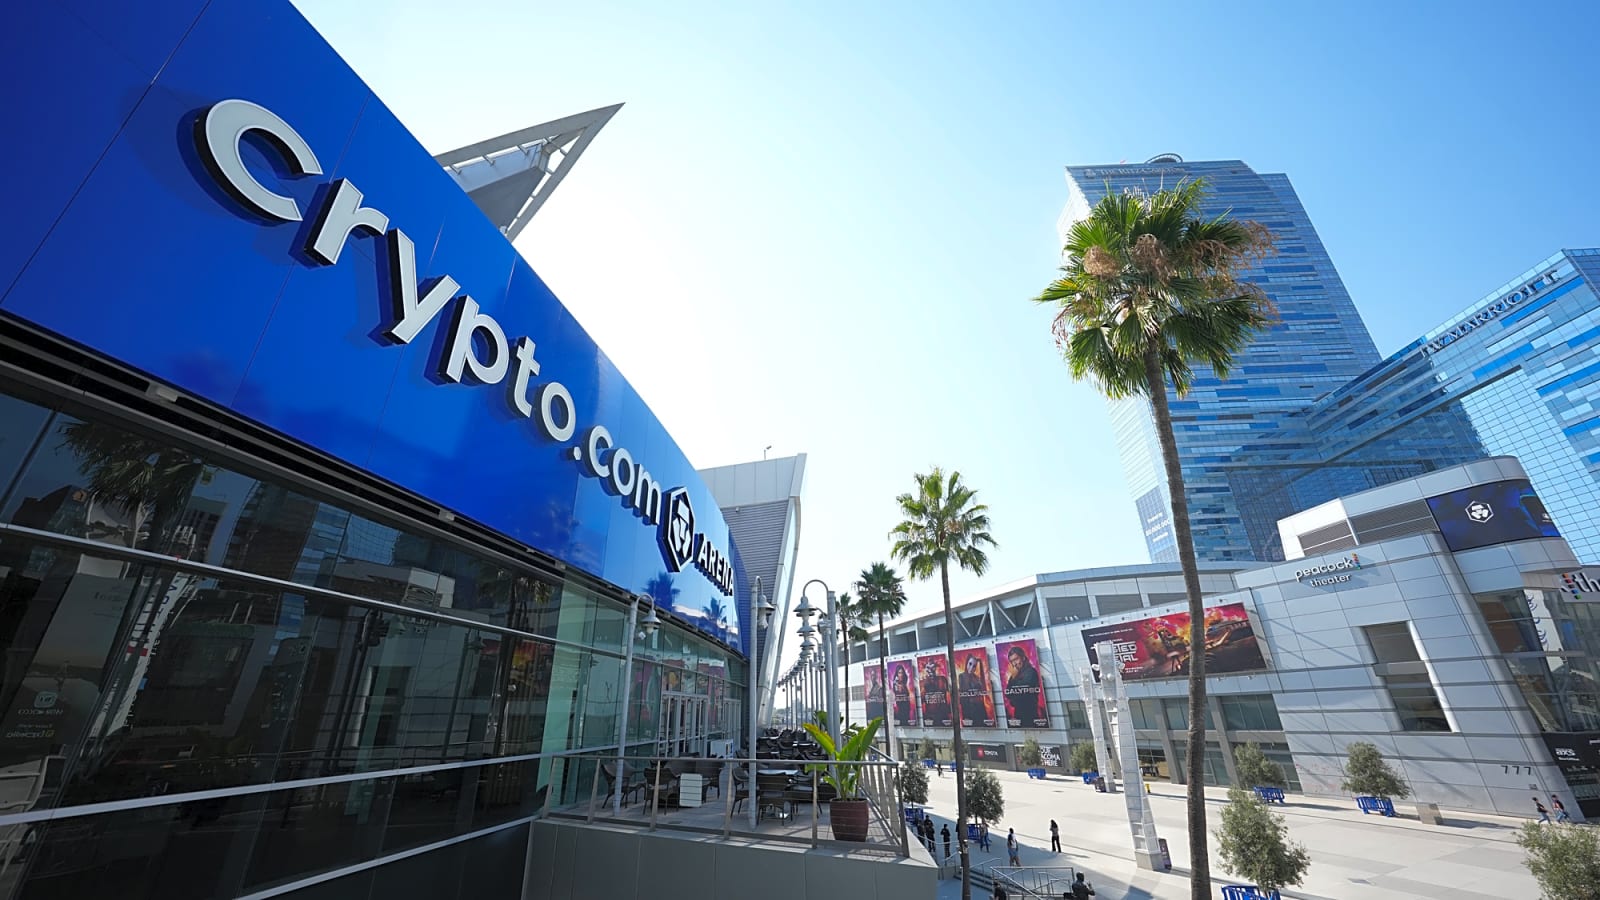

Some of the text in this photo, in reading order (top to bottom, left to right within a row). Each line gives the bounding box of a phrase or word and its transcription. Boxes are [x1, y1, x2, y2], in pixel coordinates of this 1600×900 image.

[203, 98, 661, 526] crypto.com
[1444, 269, 1561, 342] MARRIOTT
[697, 534, 735, 597] ARENA
[1295, 556, 1353, 583] peacock
[1310, 574, 1351, 588] theater
[1574, 572, 1600, 593] th
[1003, 687, 1041, 695] CALYPSO
[1041, 753, 1061, 762] ACOMA
[1501, 764, 1531, 776] 777
